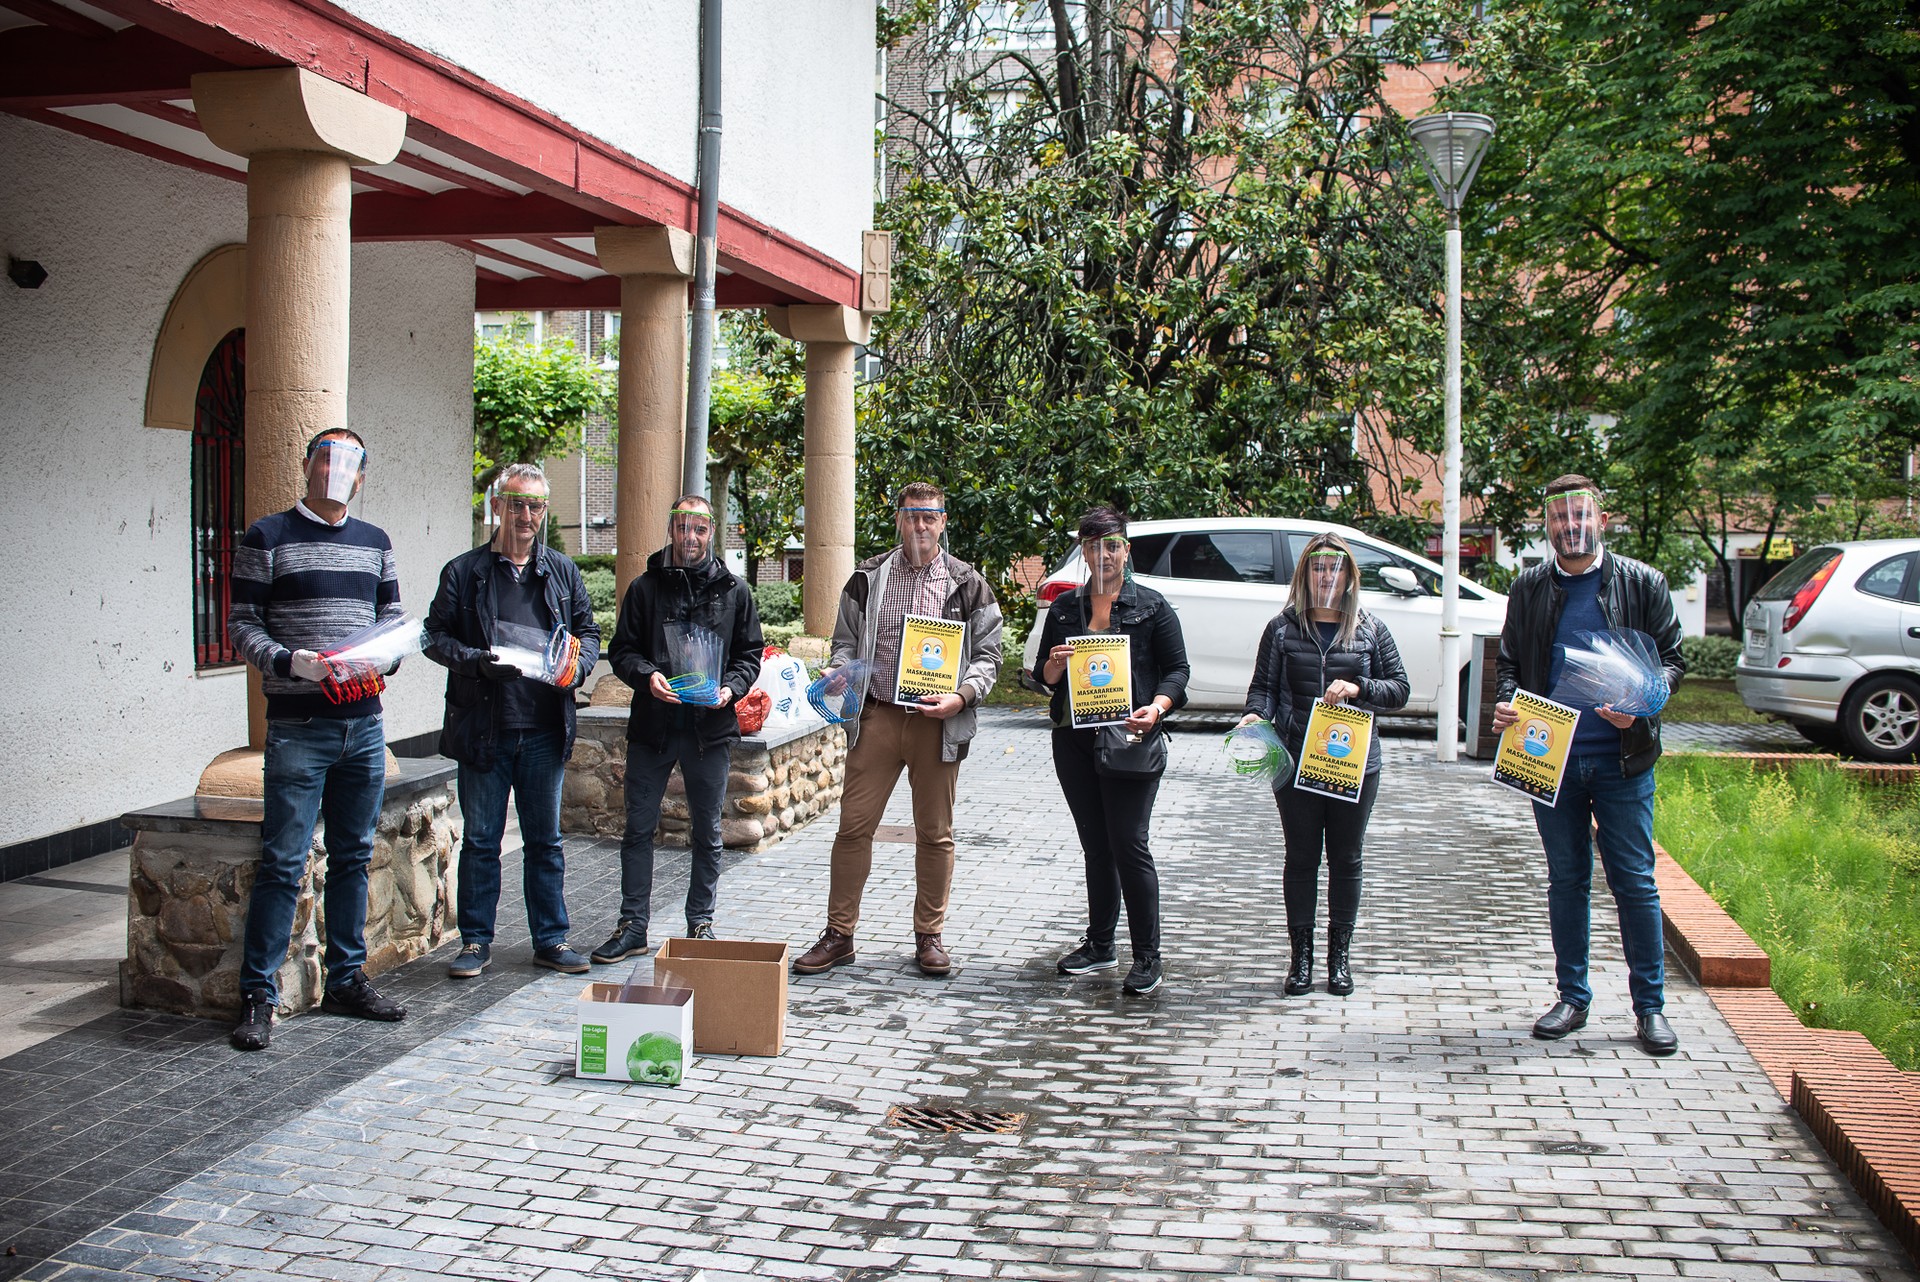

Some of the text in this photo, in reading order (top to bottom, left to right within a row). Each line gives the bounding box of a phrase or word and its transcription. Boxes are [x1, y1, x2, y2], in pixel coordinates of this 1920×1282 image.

[906, 669, 952, 680] MASKARAREKIN
[927, 682, 952, 690] MASCARILLA
[1077, 687, 1123, 696] MASKARAREKIN
[1309, 754, 1358, 769] MASKARAREKIN
[1506, 748, 1556, 771] MASKARAREKIN
[1522, 761, 1536, 769] SARTU
[1330, 770, 1357, 780] MASCARILLA
[1501, 759, 1515, 768] ENTRA
[1526, 768, 1554, 784] MASCARILLA
